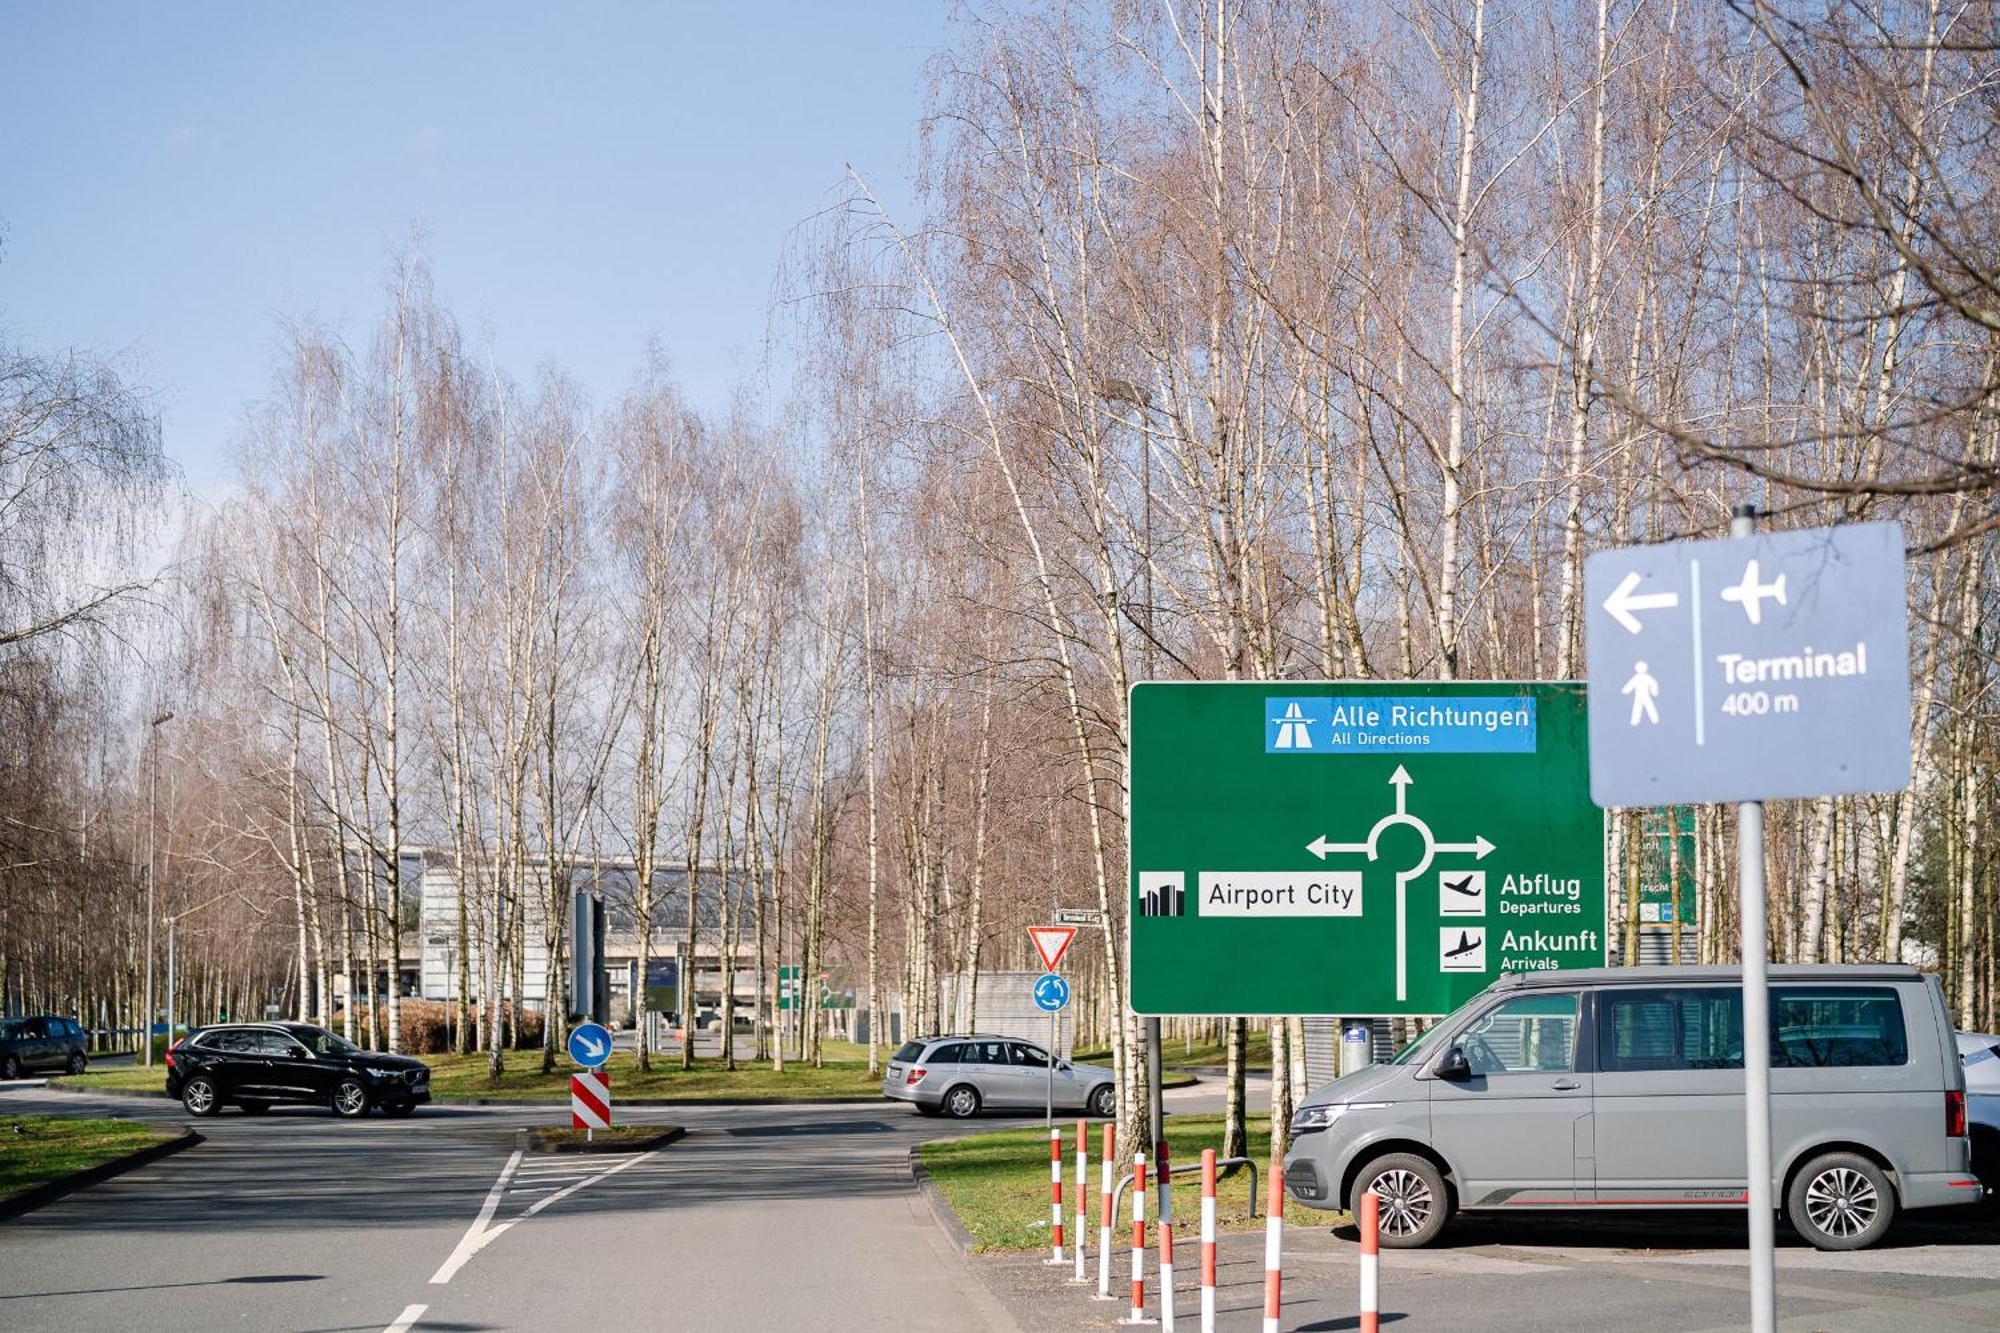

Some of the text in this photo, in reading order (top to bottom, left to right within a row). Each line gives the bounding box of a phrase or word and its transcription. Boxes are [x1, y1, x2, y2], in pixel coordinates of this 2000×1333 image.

[1717, 643, 1866, 683] Terminal
[1722, 692, 1798, 715] 400 m
[1332, 706, 1528, 731] Alle Richtungen
[1332, 732, 1430, 744] All Directions
[1209, 884, 1353, 909] Airport City
[1501, 874, 1580, 900] Abflug
[1500, 901, 1580, 916] Departures
[1501, 930, 1596, 951] Ankunft
[1501, 957, 1558, 971] Arrivals
